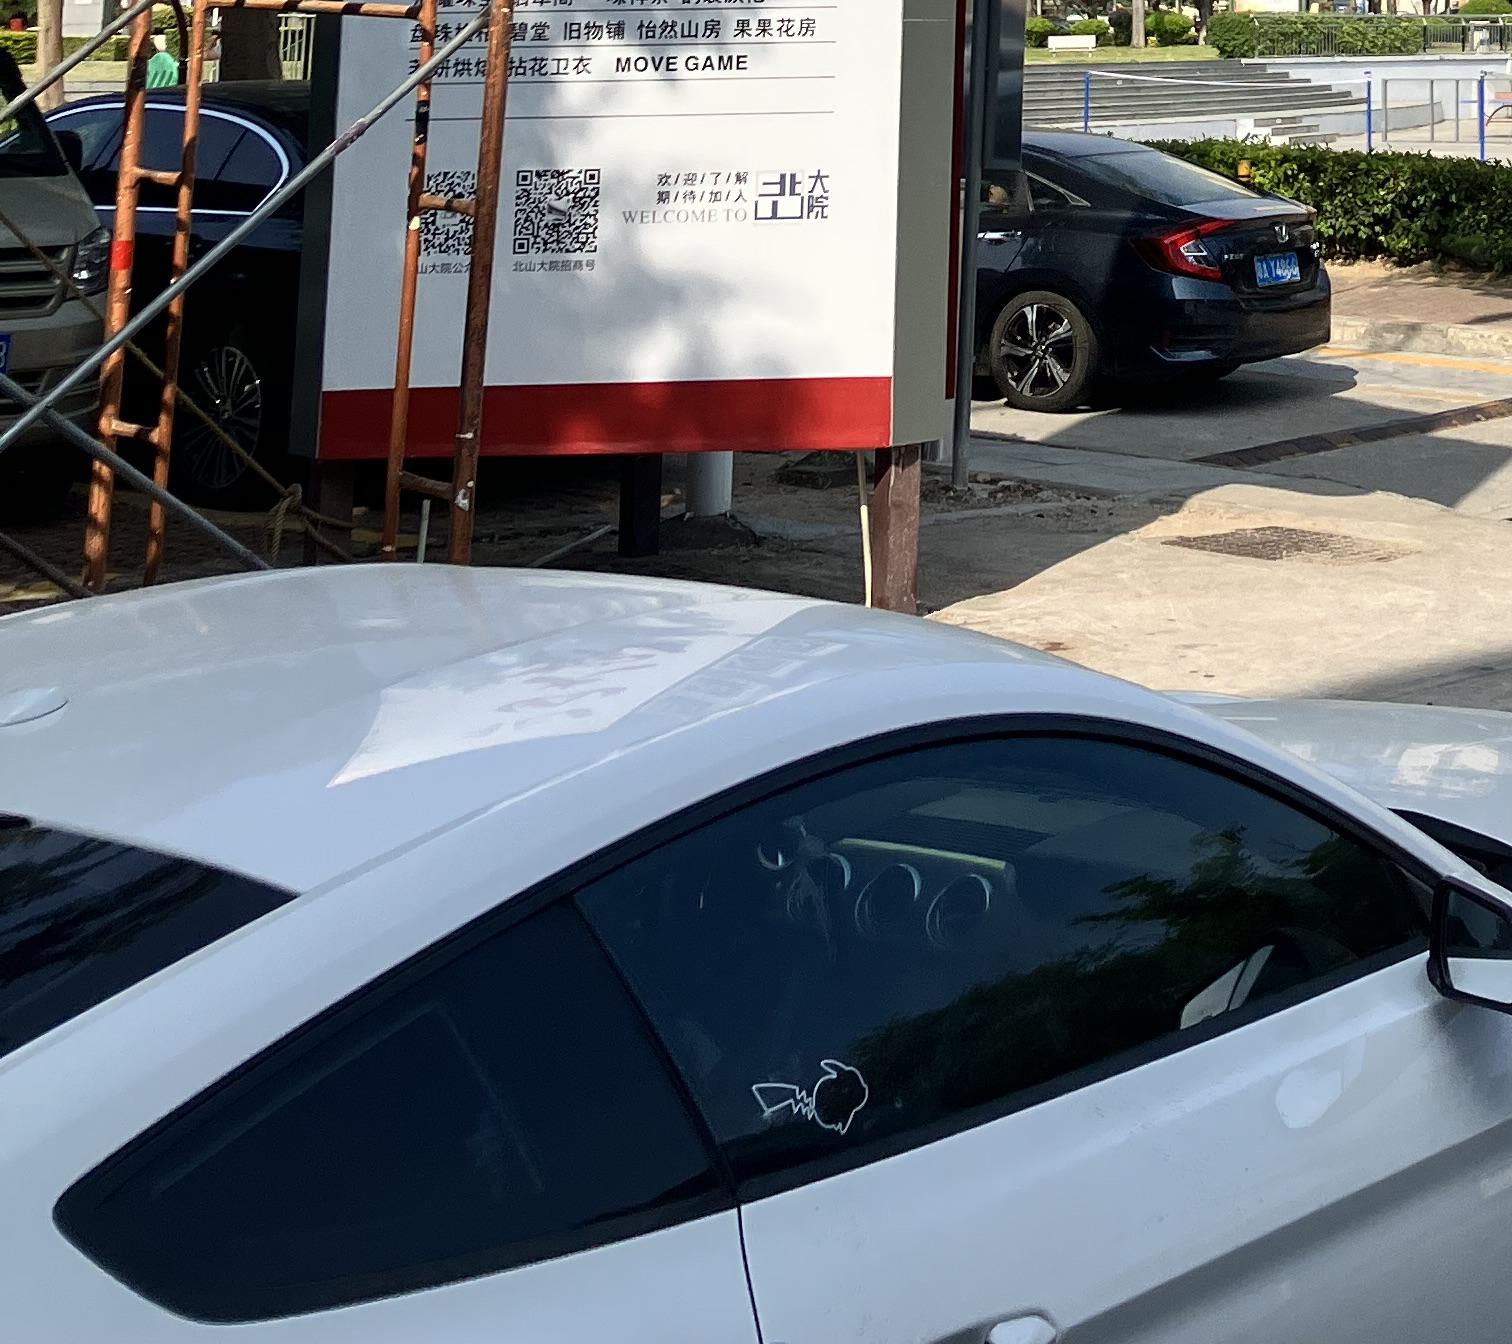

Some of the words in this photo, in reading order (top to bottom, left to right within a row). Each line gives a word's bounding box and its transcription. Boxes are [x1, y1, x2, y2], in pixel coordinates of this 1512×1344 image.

[564, 20, 625, 41] 旧物铺
[637, 19, 721, 40] 怡然山房
[733, 17, 816, 38] 果果花房
[616, 56, 678, 72] MOVE
[685, 55, 748, 71] GAME
[622, 209, 718, 224] WELCOME
[724, 208, 747, 223] TO
